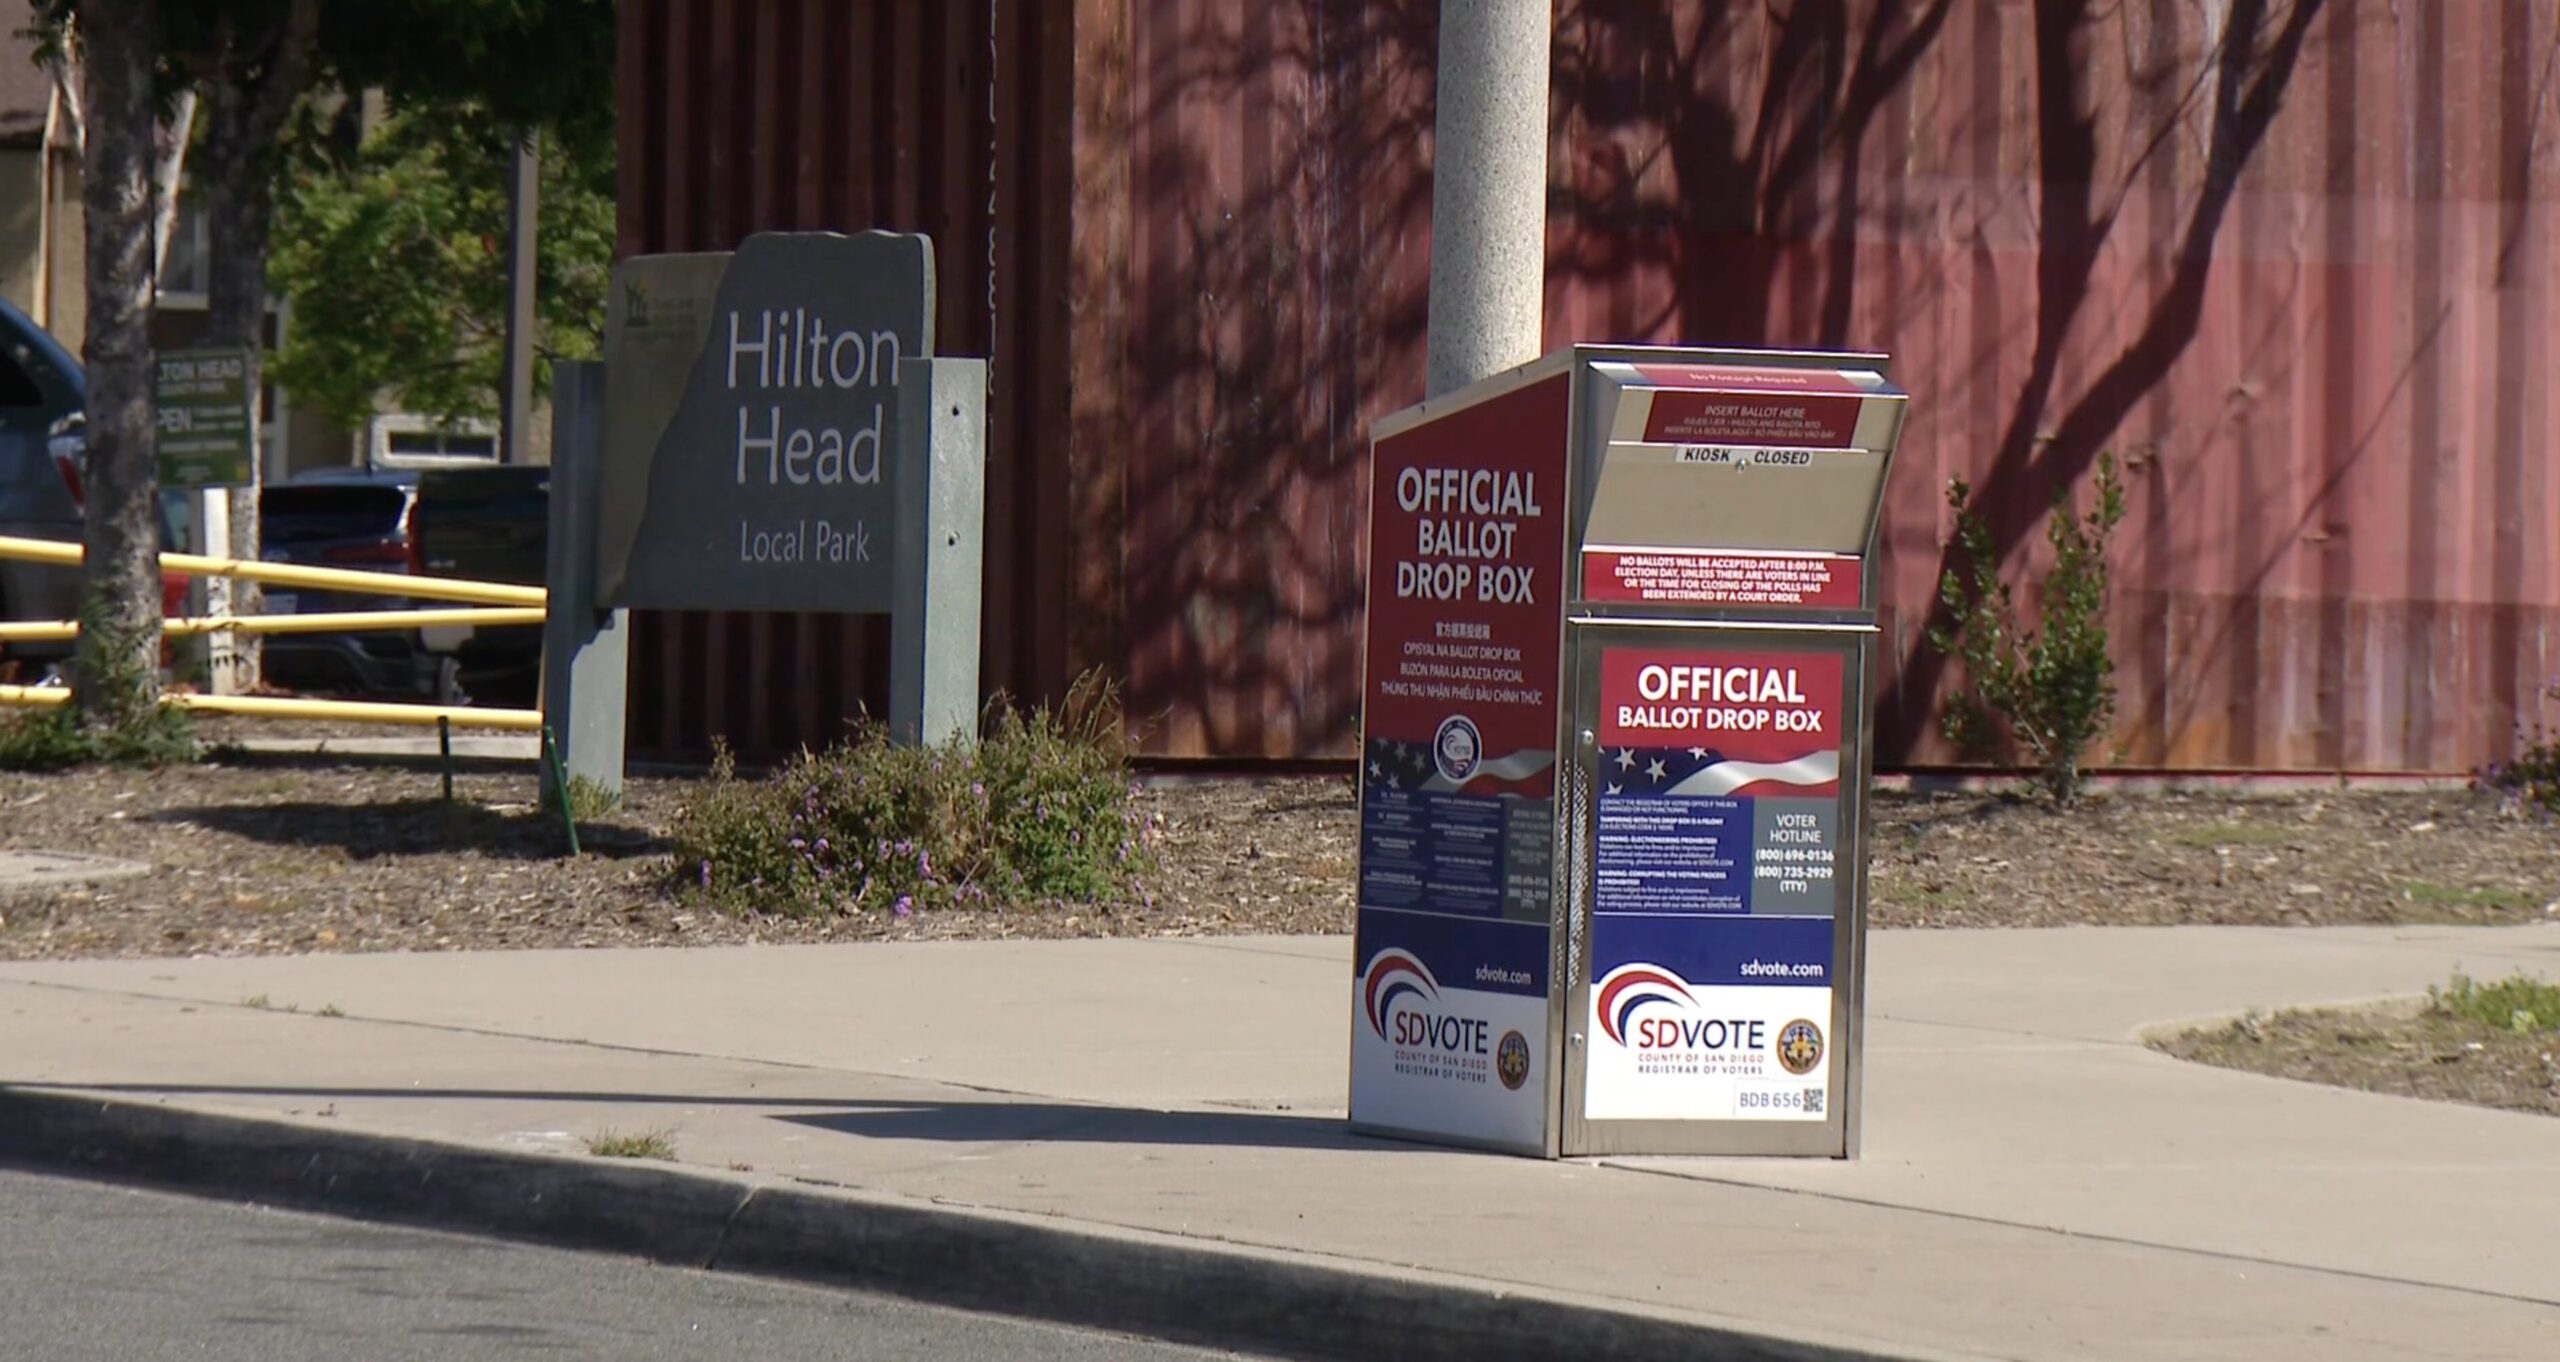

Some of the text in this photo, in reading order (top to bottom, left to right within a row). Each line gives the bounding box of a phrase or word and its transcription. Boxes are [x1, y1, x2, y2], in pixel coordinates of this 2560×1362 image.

[729, 308, 899, 388] Hilton
[198, 359, 242, 379] HEAD
[1705, 405, 1805, 418] INSERT BALLOT HERE
[737, 405, 881, 484] Head
[1684, 448, 1810, 465] KIOSK CLOSED
[1398, 467, 1540, 516] OFFICIAL
[742, 522, 869, 561] Local Park
[1420, 520, 1516, 558] BALLOT
[1620, 555, 1827, 571] NO BALLOTS WILL BE ACCEPTED AFTER 8:00 P.M.
[1399, 562, 1534, 603] DROP BOX
[1615, 567, 1831, 583] ELECTION DAY, UNLESS THERE ARE VOTERS IN LINE
[1624, 578, 1821, 593] OR THE TIME FOR CLOSING OF THE POLLS HAS
[1642, 589, 1803, 603] BEEN EXTENDED BY A COURT ORDER.
[1404, 642, 1521, 662] OPISYAL NA BALLOT DROP BOX
[1400, 661, 1524, 683] BUZÓN PARA LA BOLETA OFICIAL
[1639, 666, 1805, 703] OFFICIAL
[1617, 706, 1823, 732] BALLOT DROP BOX
[1776, 814, 1817, 828] VOTER
[1769, 829, 1822, 844] HOTLINE
[1755, 849, 1835, 862] (800) 696-0136
[1754, 866, 1834, 879] (800) 735-2929
[1780, 881, 1808, 894] (TTY)
[1475, 963, 1532, 985] sdvote.com
[1740, 958, 1824, 978] sdvote.com
[1396, 1011, 1487, 1054] SDVOTE
[1640, 1019, 1764, 1049] SDVOTE
[1395, 1050, 1488, 1071] COUNTY OF SAN DIEGO
[1638, 1053, 1765, 1064] COUNTY OF SAN DIEGO
[1394, 1063, 1487, 1083] REGISTRAR OF VOTERS
[1638, 1064, 1763, 1075] REGISTRAR OF VOTERS
[1739, 1092, 1802, 1108] BDB 656
